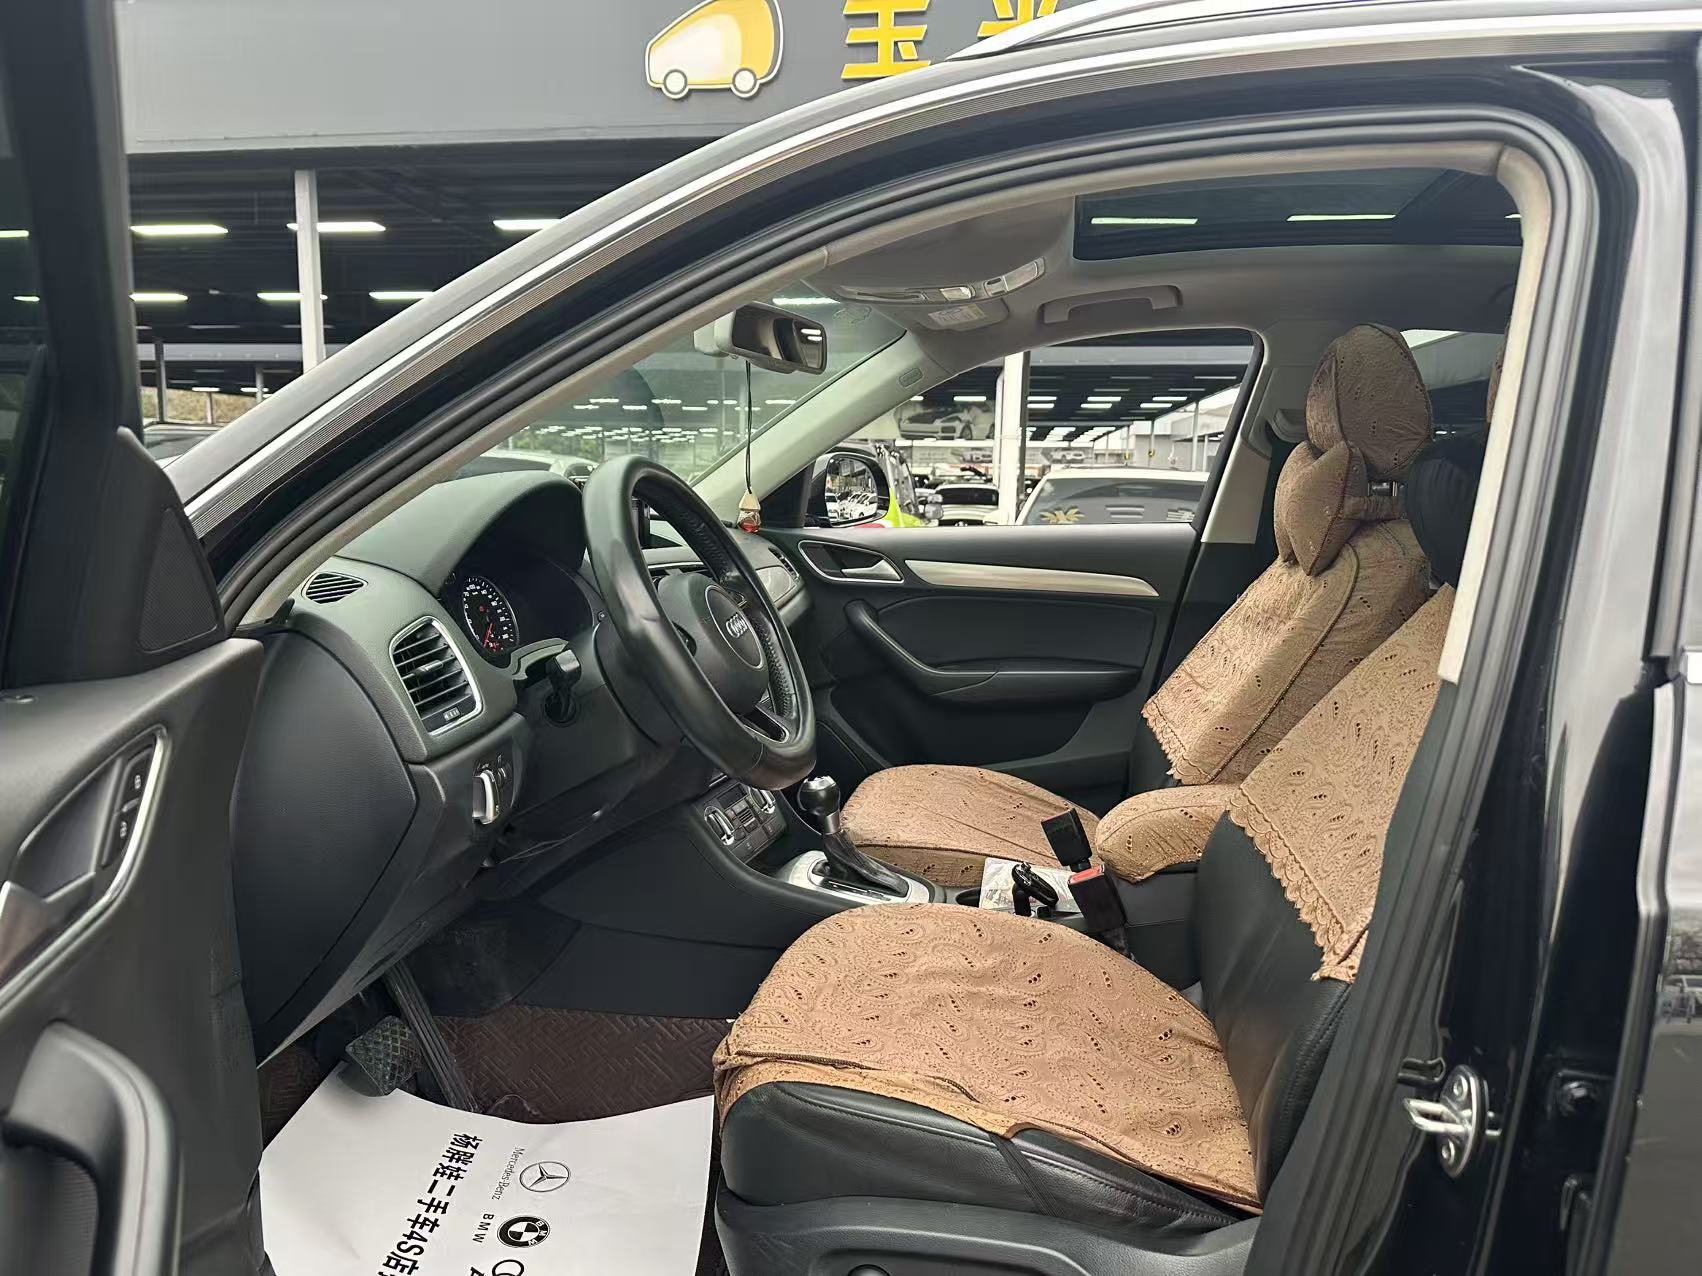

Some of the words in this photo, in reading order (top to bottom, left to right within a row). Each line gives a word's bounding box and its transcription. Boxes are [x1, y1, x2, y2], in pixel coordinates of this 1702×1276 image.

[378, 1133, 482, 1276] 杨胖娃二手车4S店
[472, 1213, 495, 1243] BMW
